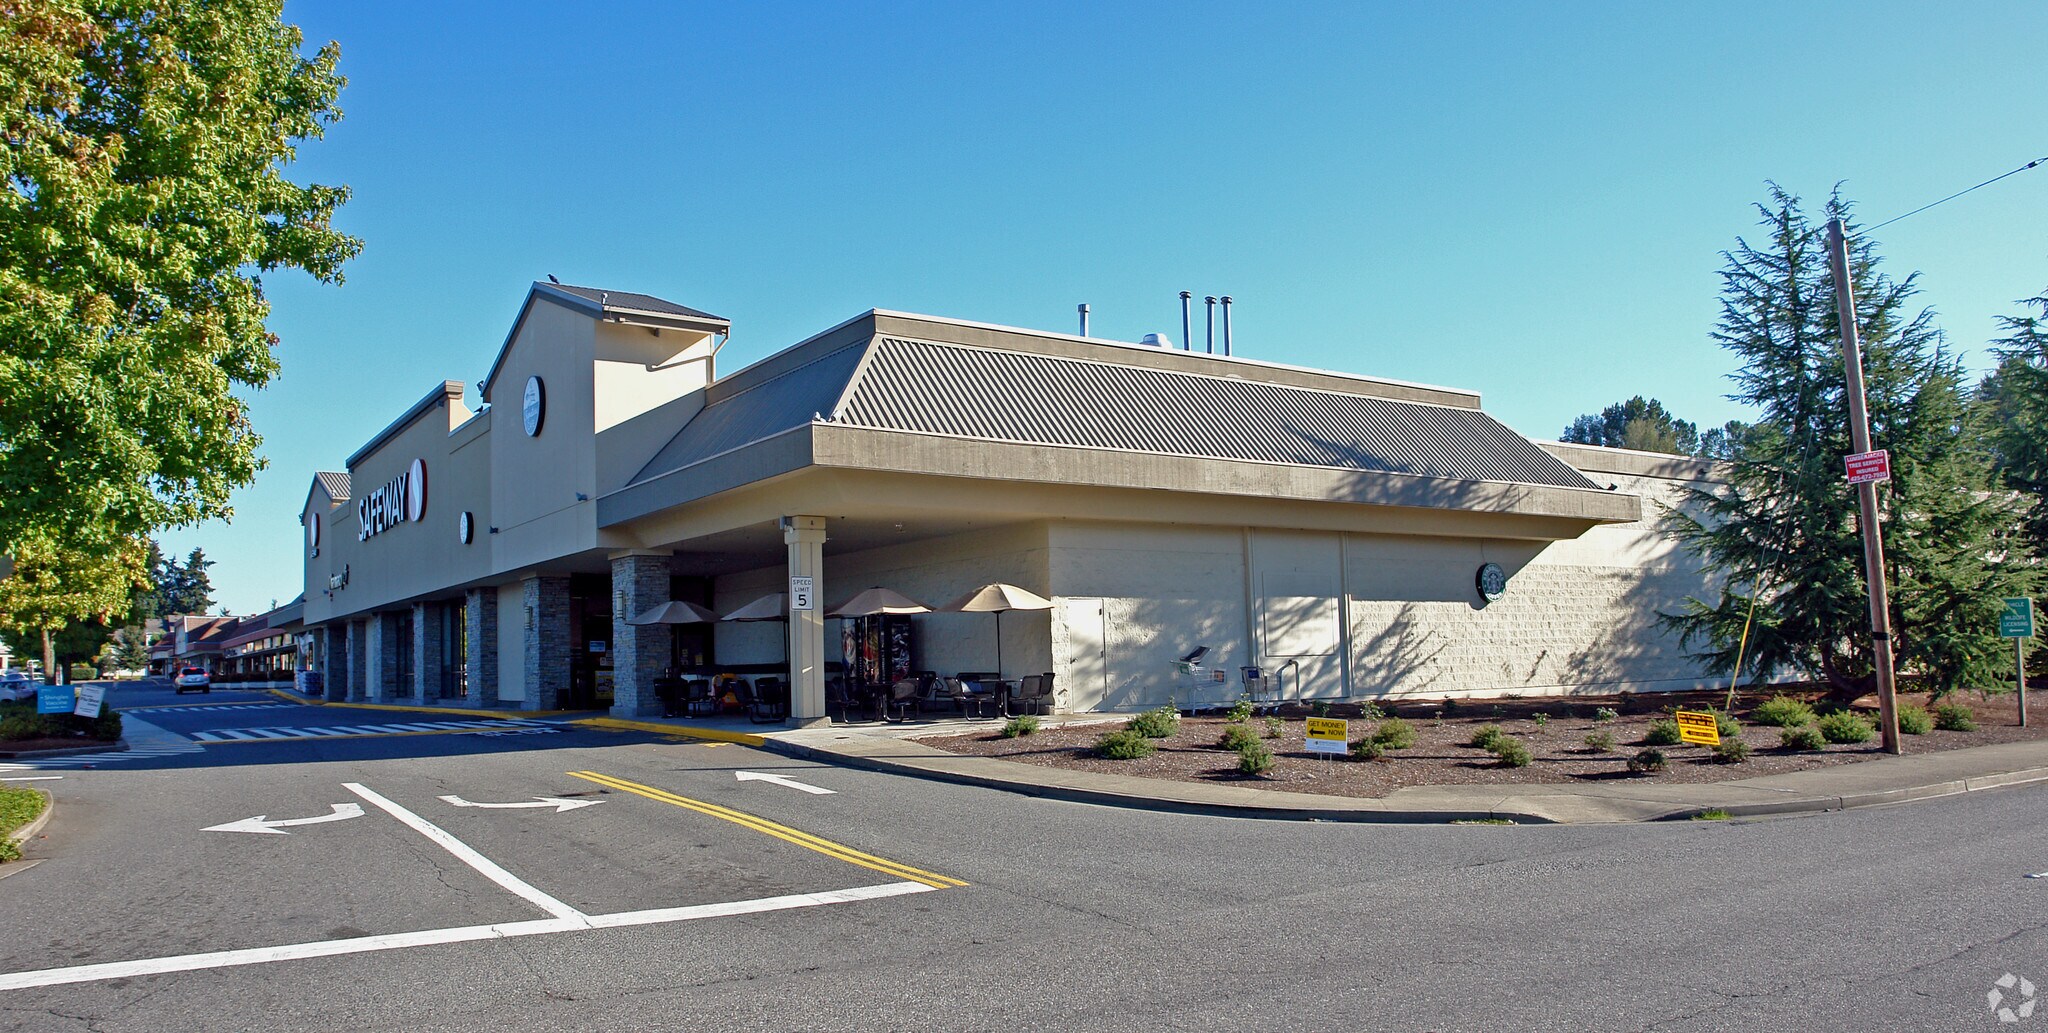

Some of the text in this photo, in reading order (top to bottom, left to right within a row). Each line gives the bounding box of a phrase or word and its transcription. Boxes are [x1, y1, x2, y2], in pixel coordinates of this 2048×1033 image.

[358, 472, 408, 541] SAFEWAY
[798, 594, 807, 606] 5
[1321, 721, 1345, 729] MONEY
